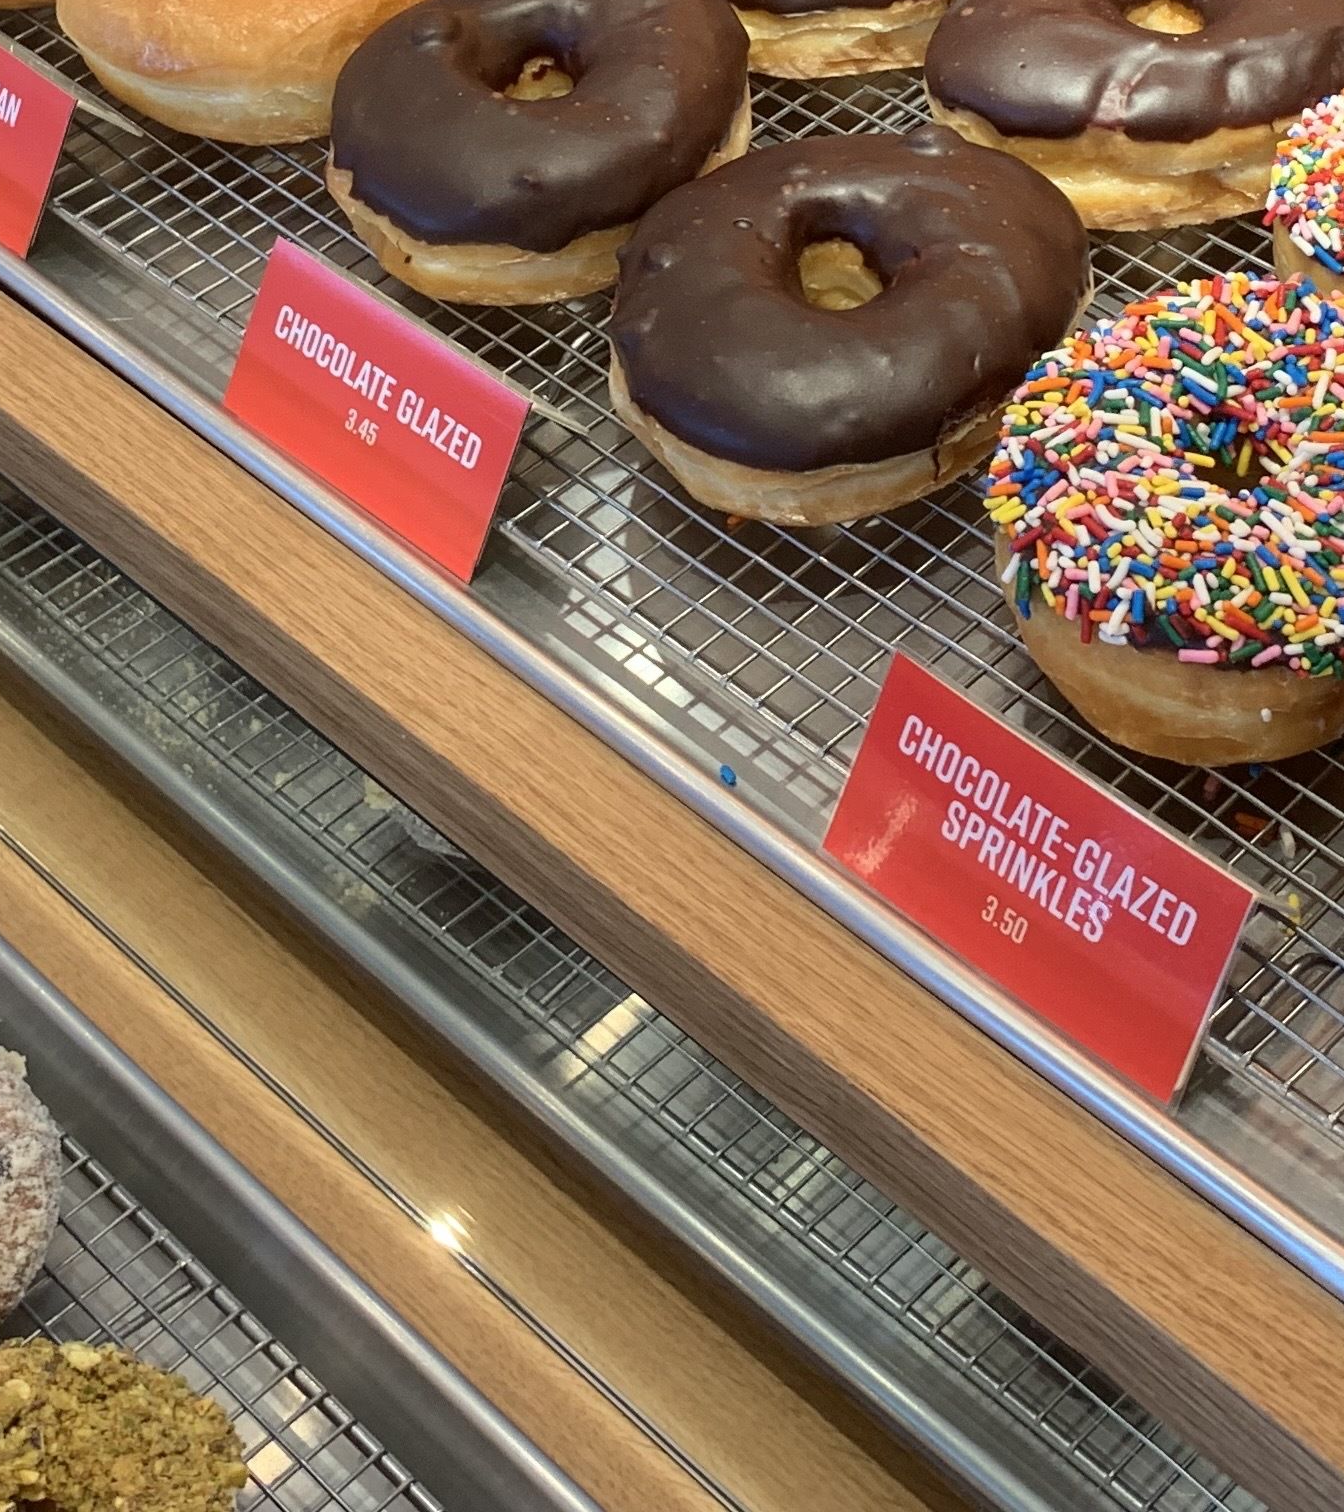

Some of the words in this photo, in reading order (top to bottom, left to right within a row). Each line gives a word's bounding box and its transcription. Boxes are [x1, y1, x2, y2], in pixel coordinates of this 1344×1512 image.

[274, 304, 397, 412] CHOCOLATE
[396, 387, 482, 470] GLAZED
[344, 408, 378, 446] 3.45
[898, 714, 1197, 947] CHOCOLATE-GLAZED
[941, 800, 1111, 943] SPRINKLES
[981, 895, 1028, 945] 3.50
